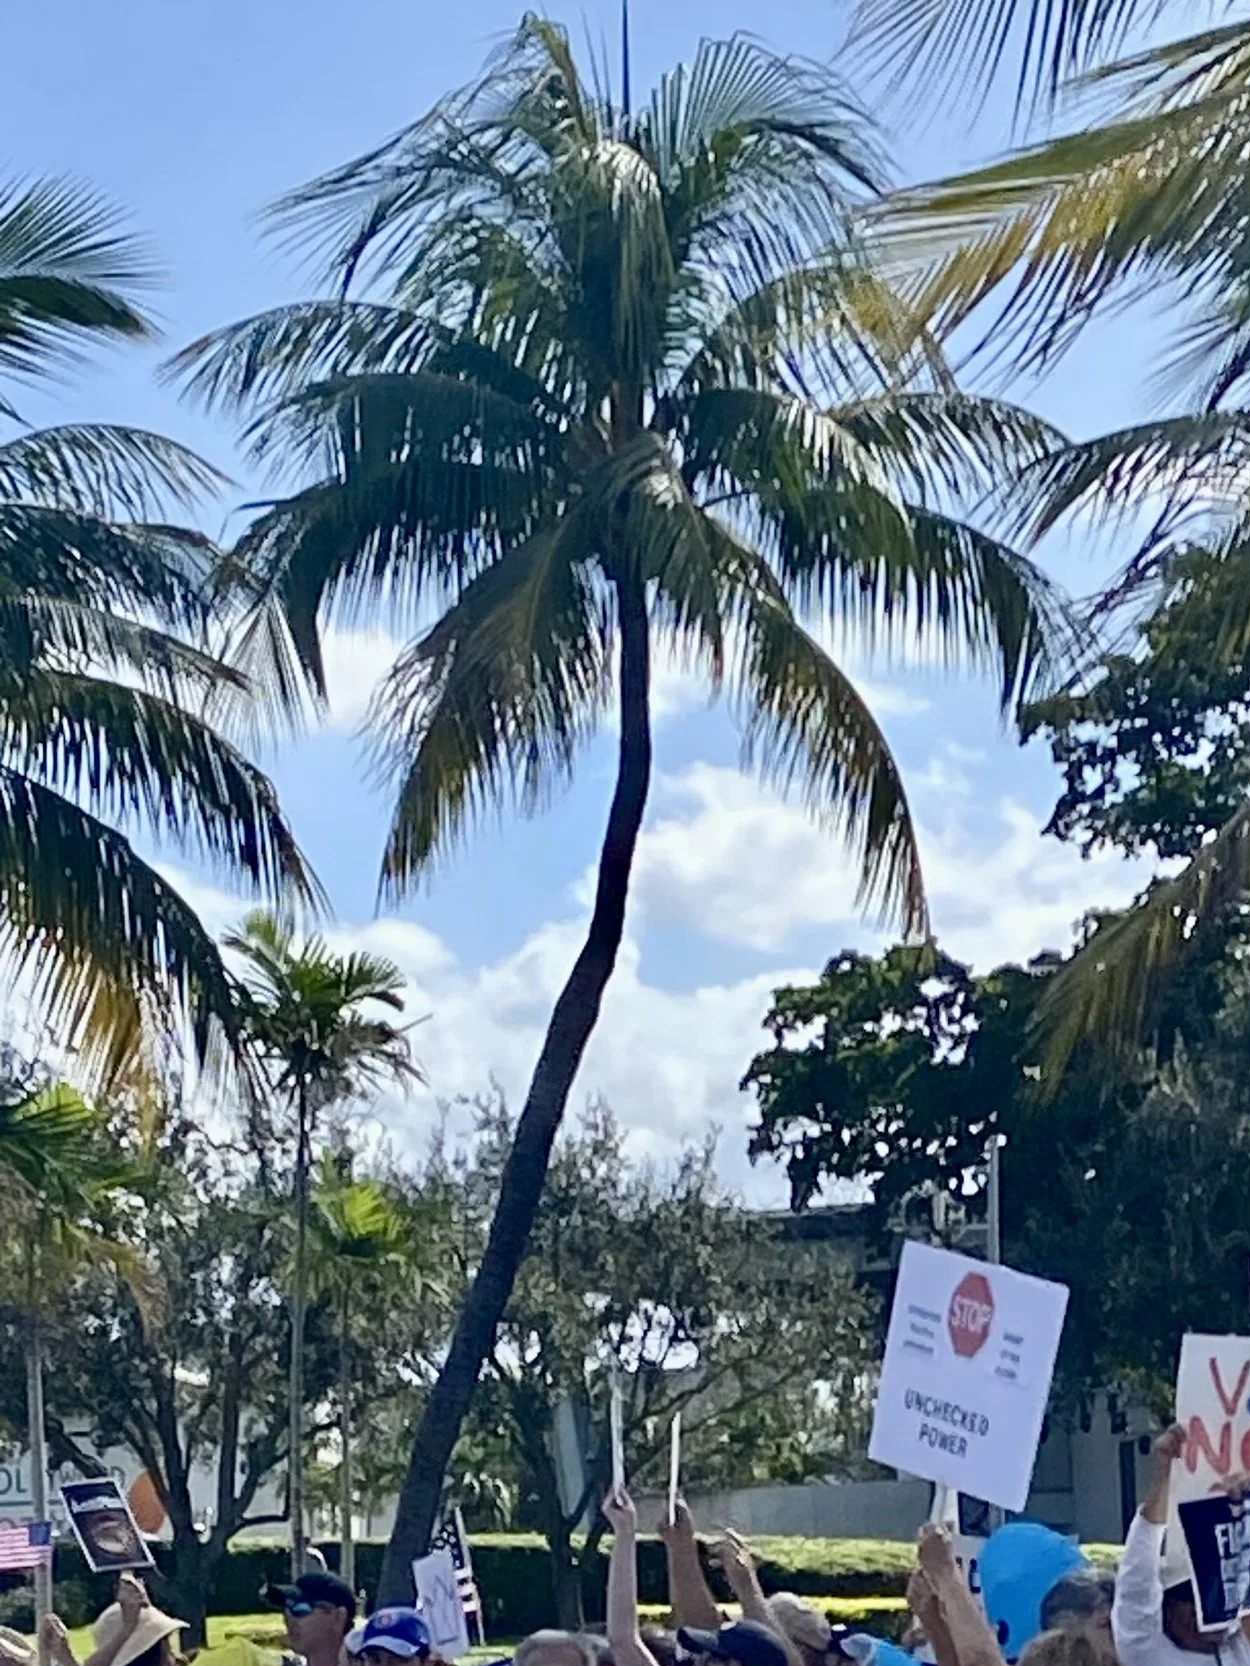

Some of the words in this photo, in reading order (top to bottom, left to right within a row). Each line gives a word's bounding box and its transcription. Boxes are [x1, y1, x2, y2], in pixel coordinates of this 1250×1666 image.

[951, 1295, 993, 1333] STOP
[903, 1388, 990, 1437] UNCHECKED
[918, 1422, 969, 1459] POWER
